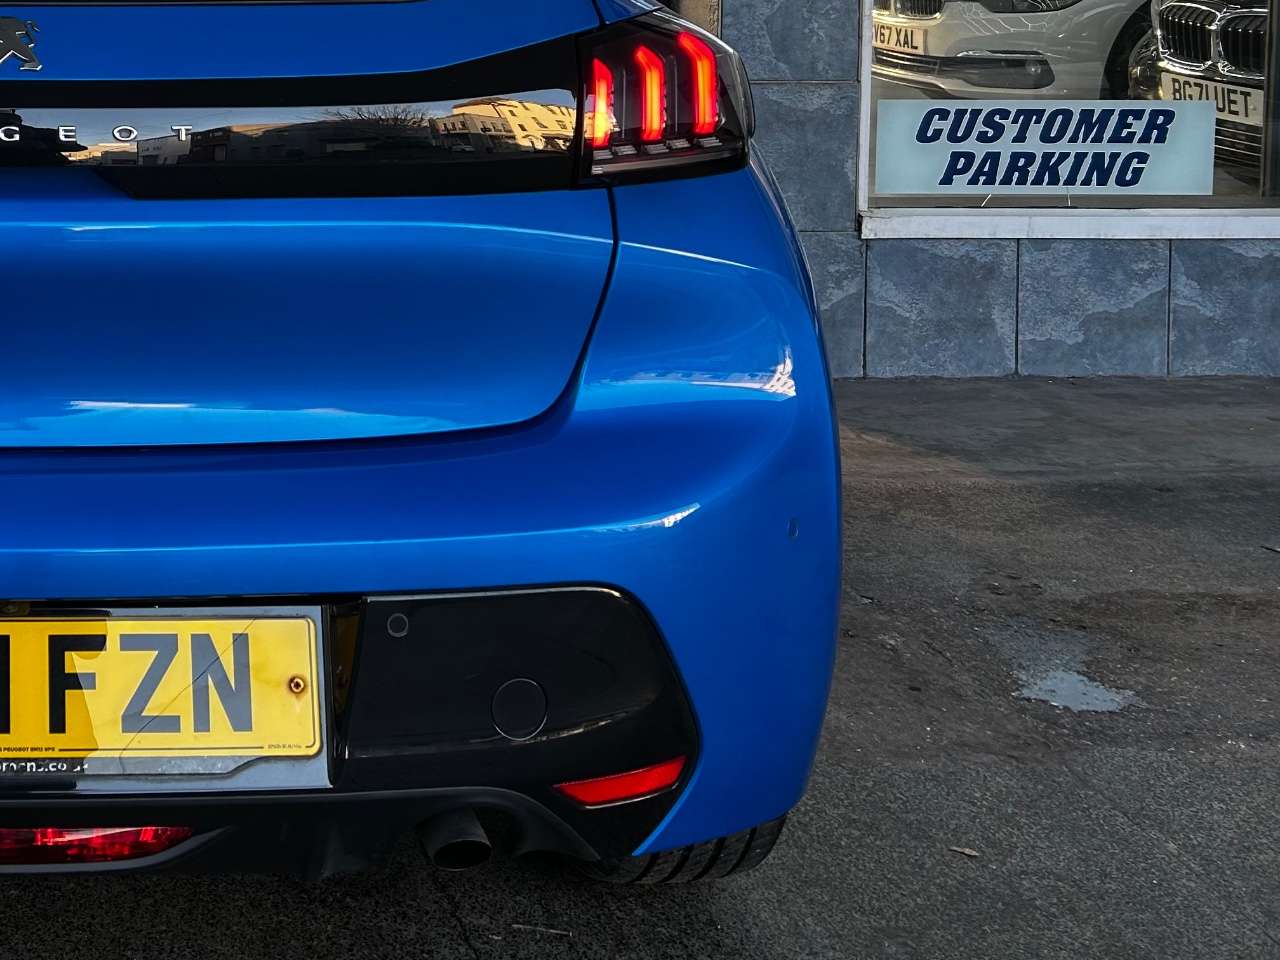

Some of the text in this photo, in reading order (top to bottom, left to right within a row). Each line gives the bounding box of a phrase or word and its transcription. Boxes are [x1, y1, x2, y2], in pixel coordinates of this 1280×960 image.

[895, 27, 919, 50] XAL
[1214, 85, 1252, 118] UET
[915, 107, 1177, 145] CUSTOMER
[938, 151, 1151, 187] PARKING
[47, 631, 254, 736] FZN
